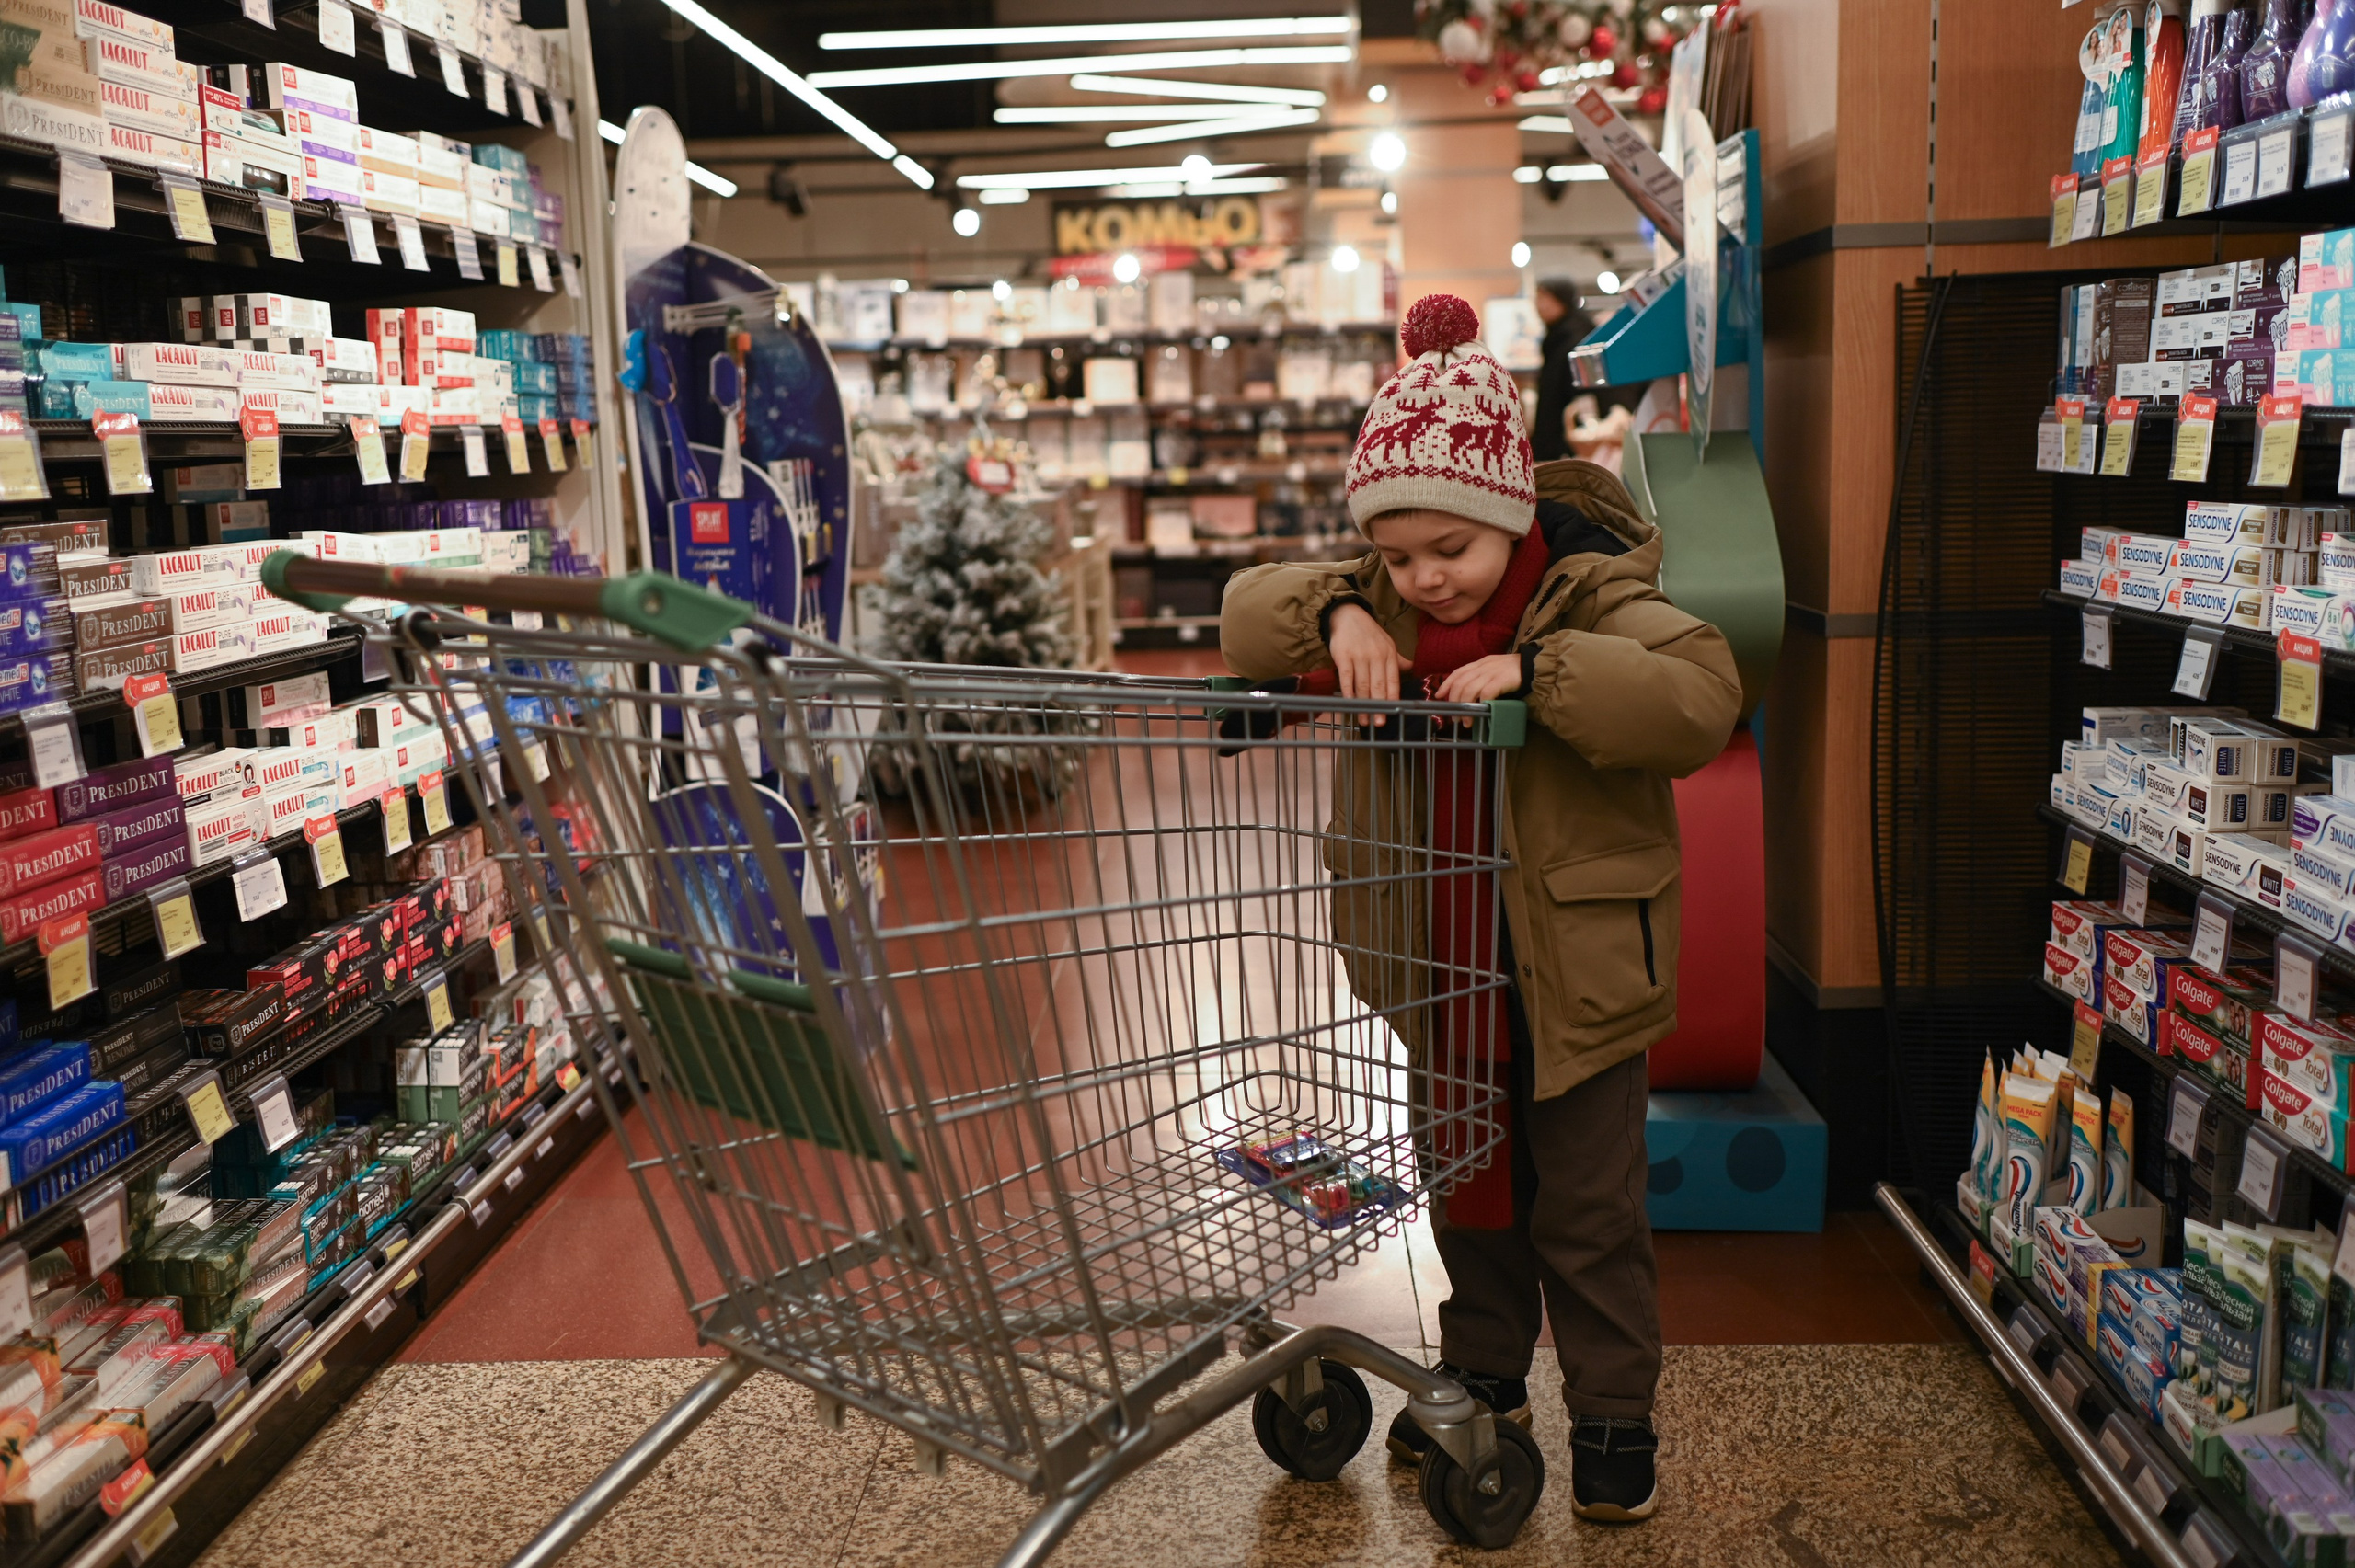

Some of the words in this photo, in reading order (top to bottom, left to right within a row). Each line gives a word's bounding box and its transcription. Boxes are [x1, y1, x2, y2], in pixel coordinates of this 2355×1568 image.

[78, 0, 125, 29] LACALUT
[100, 40, 148, 71] LACALUT
[36, 78, 96, 104] PRESIDENT
[100, 83, 150, 111] LACALUT
[31, 114, 104, 147] PRESIDENT
[110, 128, 153, 154] ACALUT
[2196, 134, 2211, 146] АКЦИЯ
[2118, 283, 2148, 292] CORIMO
[2277, 265, 2297, 291] Dent
[155, 346, 198, 365] LACALUT
[200, 350, 215, 361] PURE
[244, 354, 276, 372] ACALUT
[2247, 359, 2264, 368] CORIMO
[2224, 368, 2244, 393] Dent
[93, 398, 145, 410] PRESIDENT
[2118, 406, 2131, 415] АКЦИЯ
[2193, 403, 2210, 413] АКЦИЯ
[2275, 403, 2294, 415] АКЦИЯ
[2188, 513, 2232, 532] SENSODYNE
[159, 554, 201, 575] LACALUT
[203, 554, 218, 563] PURE
[2123, 547, 2162, 565] SENSODYNE
[2180, 553, 2224, 571] SENSODYNE
[67, 573, 134, 597] PRESIDENT
[2063, 571, 2094, 589] SENSODYNE
[2122, 582, 2160, 601] SENSODYNE
[181, 591, 215, 613] LACALUT
[217, 591, 230, 600] PURE
[2183, 591, 2226, 612] SENSODYNE
[102, 611, 167, 637] PRESIDENT
[256, 617, 290, 636] LACALUT
[292, 615, 304, 624] PURE
[2275, 604, 2318, 624] SENSODYNE
[180, 631, 216, 654] LACALUT
[219, 629, 231, 638] PURE
[2293, 643, 2313, 656] АКЦИЯ
[105, 651, 168, 679] PRESIDENT
[142, 681, 160, 692] АКЦИЯ
[262, 689, 273, 701] SPLAT
[2188, 730, 2206, 747] SENSODYNE
[263, 759, 300, 784] LACALUT
[301, 756, 315, 765] PURE
[2107, 754, 2128, 775] SENSODYNE
[2218, 749, 2227, 773] WHITE
[2284, 750, 2293, 773] WHITE
[89, 769, 167, 803] PRESIDENT
[179, 772, 218, 795] LACALUT
[219, 767, 234, 777] BLACK
[2147, 777, 2175, 797] SENSODYNE
[273, 795, 304, 819] LACALUT
[2077, 794, 2106, 818] SENSODYNE
[2191, 798, 2204, 812] WHITE
[2237, 795, 2246, 820] WHITE
[2276, 795, 2285, 820] WHITE
[114, 807, 179, 842] PRESIDENT
[198, 818, 231, 841] LACALUT
[2139, 820, 2164, 841] SENSODYNE
[15, 840, 92, 881] PRESIDENT
[2177, 843, 2189, 856] WHITE
[125, 846, 185, 884] PRESIDENT
[2205, 853, 2241, 875] SENSODYNE
[2294, 853, 2342, 888] SENSODYNE
[2262, 877, 2280, 893] WHITE
[20, 882, 96, 926] PRESIDENT
[2286, 893, 2335, 930] SENSODYNE
[61, 922, 81, 936] АКЦИЯ
[2052, 908, 2077, 930] Colgate
[2077, 931, 2089, 945] Total
[2108, 936, 2135, 962] Colgate
[2046, 948, 2074, 970] Colgate
[2074, 972, 2086, 986] Total
[2135, 964, 2150, 981] Total
[122, 971, 171, 1003] PRESIDENT
[2107, 979, 2131, 1005] Colgate
[2176, 976, 2213, 1009] Colgate
[242, 1001, 279, 1036] PRESIDENT
[2084, 1012, 2097, 1025] АКЦИЯ
[2130, 1008, 2142, 1025] Total
[103, 1032, 134, 1054] PRESIDENT
[2175, 1022, 2211, 1056] Colgate
[2264, 1023, 2303, 1056] Colgate
[106, 1042, 137, 1065] RENOME
[120, 1061, 147, 1082] PRESIDENT
[2304, 1059, 2326, 1080] Total
[9, 1059, 84, 1113] PRESIDENT
[2264, 1076, 2301, 1111] Colgate
[2007, 1105, 2024, 1116] MEGA
[2026, 1109, 2042, 1117] PACK
[47, 1100, 119, 1155] PRESIDENT
[2303, 1113, 2322, 1135] Total
[411, 1145, 435, 1172] biomed
[298, 1179, 317, 1204] biomed
[359, 1186, 385, 1217] biomed
[255, 1200, 288, 1227] YUMMY
[2012, 1190, 2021, 1236] Aquafresh
[310, 1217, 328, 1240] biomed
[257, 1252, 302, 1288] PRESIDENT
[2221, 1291, 2254, 1314] Лесной
[2221, 1301, 2252, 1322] альзам
[2135, 1321, 2145, 1333] ALL
[2151, 1335, 2162, 1352] ONE
[2219, 1333, 2252, 1353] OTAL
[2126, 1366, 2135, 1379] ALL
[2140, 1382, 2152, 1399] ONE
[121, 1469, 143, 1491] АКЦИЯ
